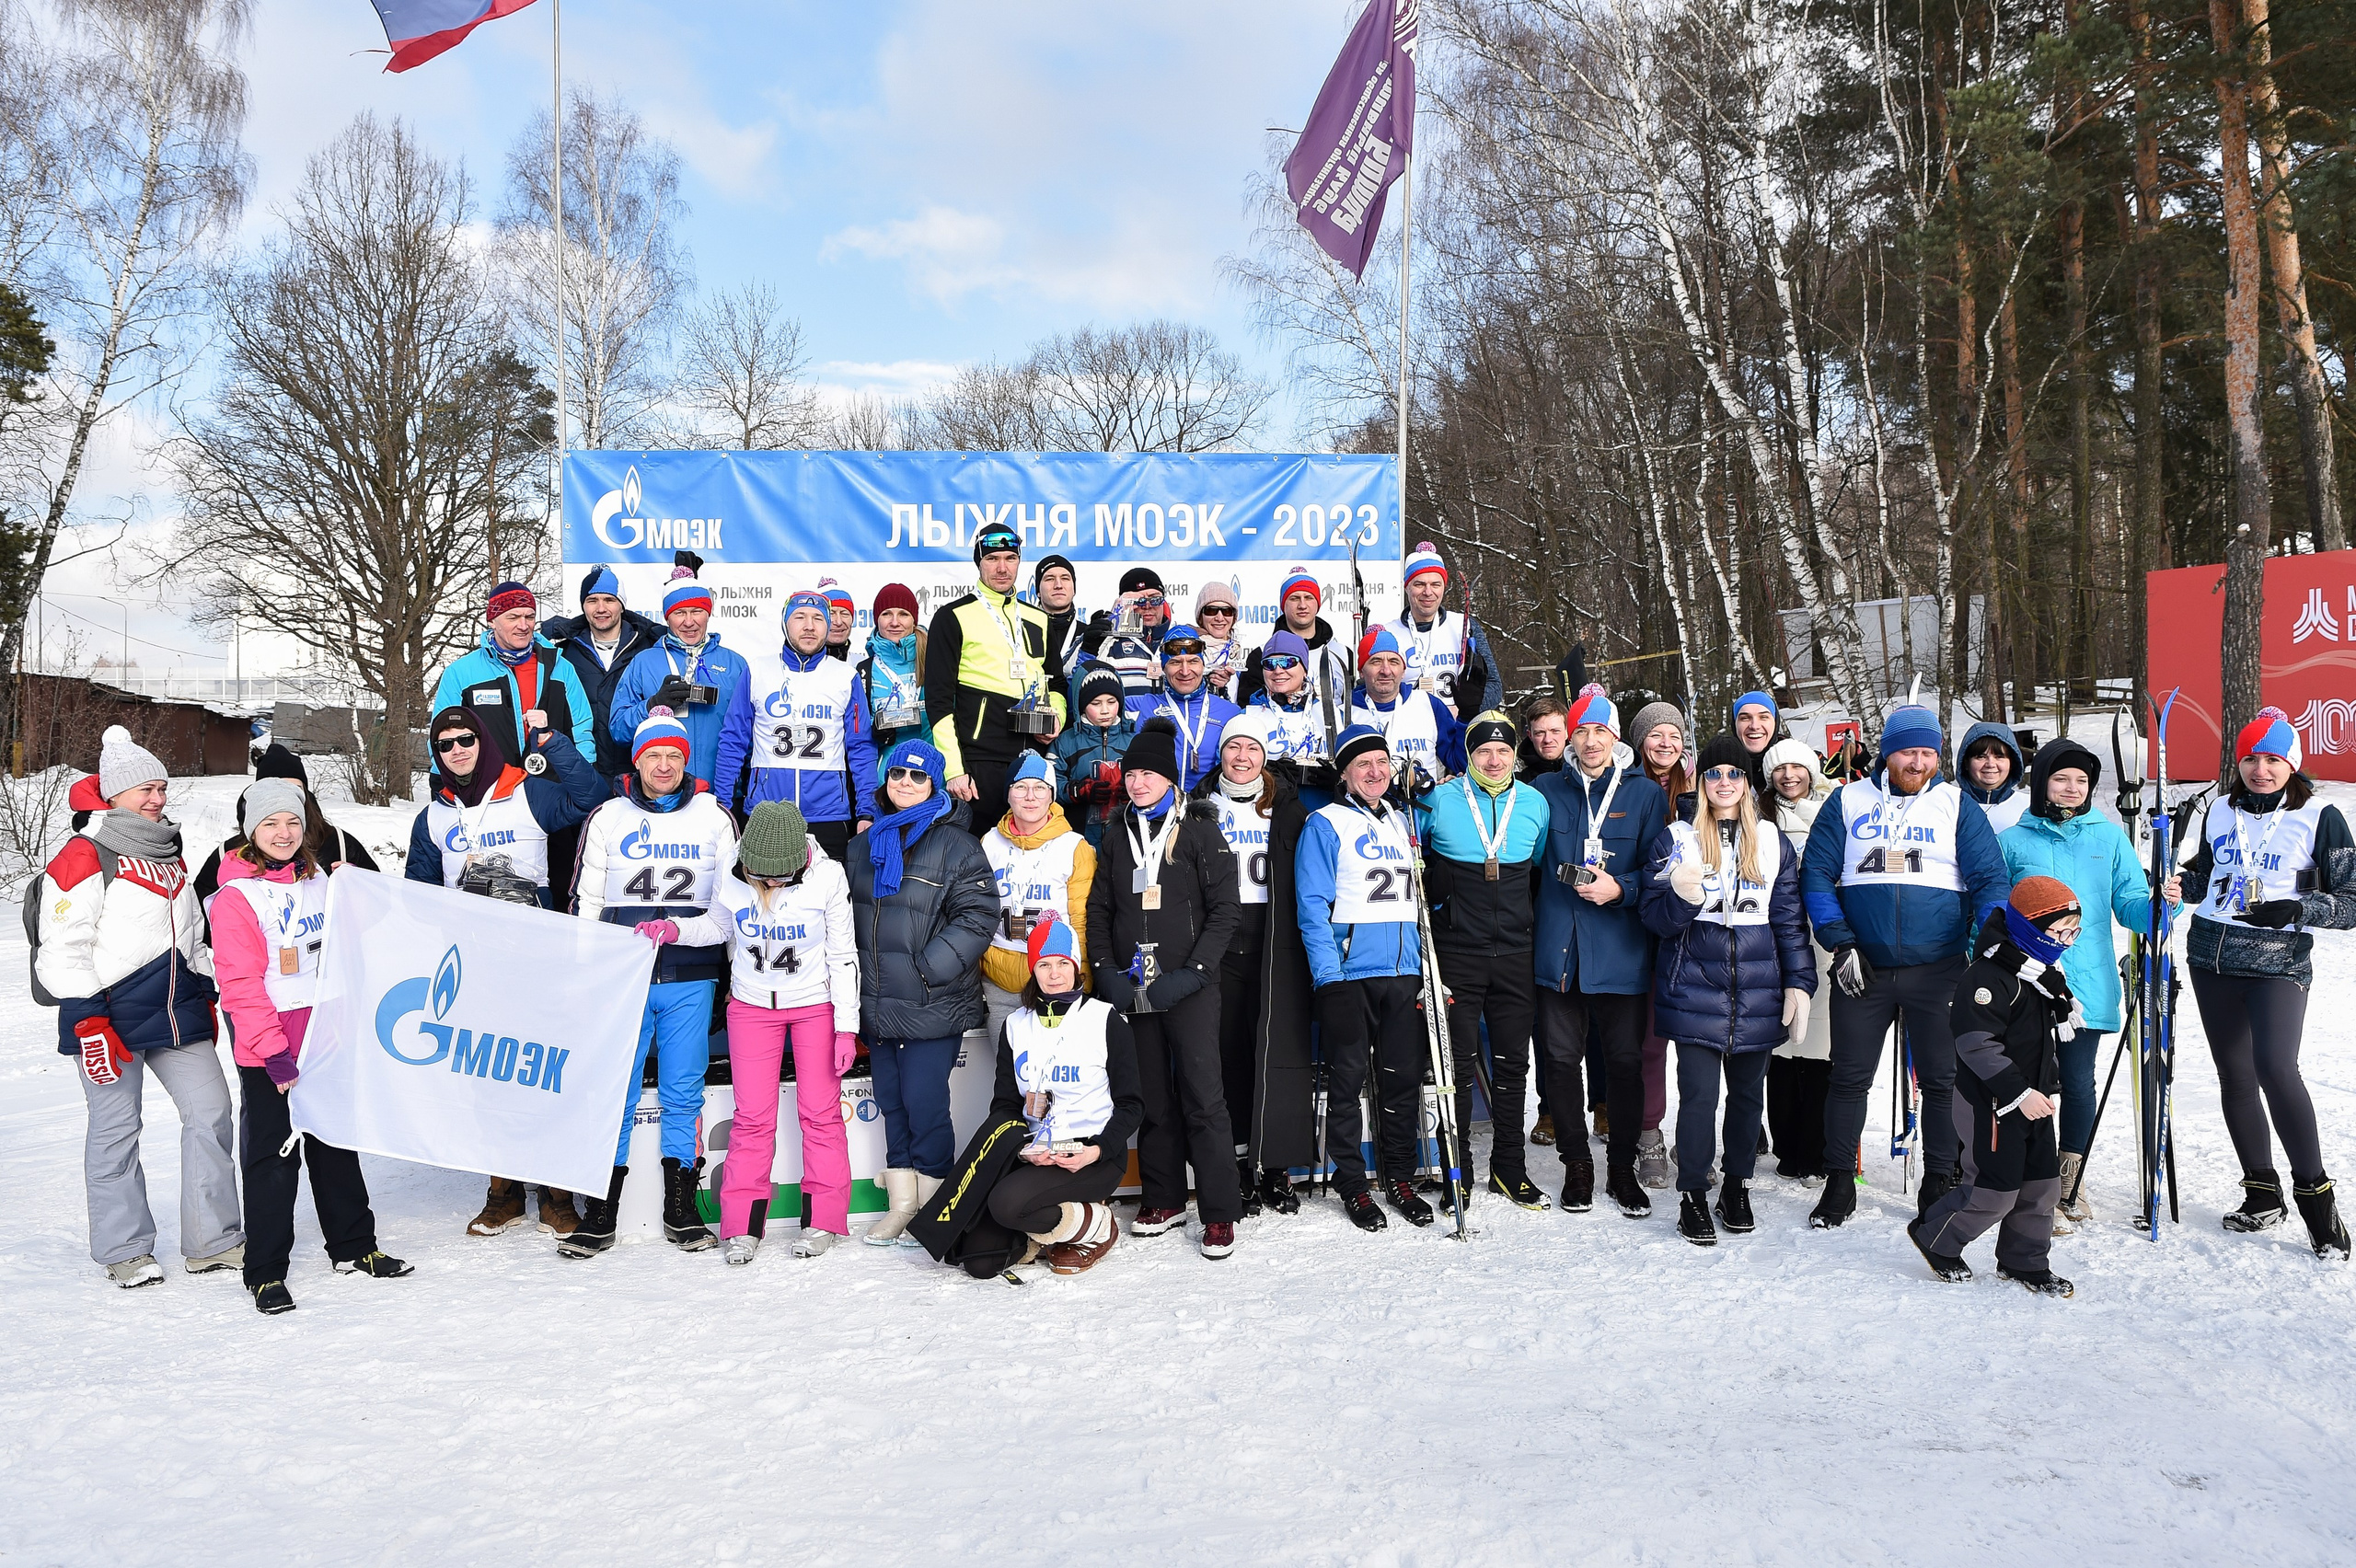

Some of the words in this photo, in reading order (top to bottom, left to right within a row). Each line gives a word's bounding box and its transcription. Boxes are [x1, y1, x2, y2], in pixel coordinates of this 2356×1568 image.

[646, 518, 722, 550] МОЭК
[886, 503, 1078, 548] ЛЫЖНЯ
[1094, 503, 1226, 548] МОЭК
[1242, 526, 1257, 535] -
[1273, 503, 1380, 547] 2023
[720, 586, 772, 599] ЛЫЖНЯ
[933, 585, 976, 598] ЛЫЖН
[721, 605, 757, 617] МОЭК
[1245, 605, 1282, 624] МОЭ
[772, 725, 825, 760] 32
[2158, 737, 2169, 816] ORDWAY
[1239, 830, 1269, 845] МОЭ
[654, 843, 701, 861] МОЭК
[1855, 847, 1923, 874] 41
[2235, 849, 2281, 871] МЭК
[623, 866, 696, 902] 42
[1026, 883, 1052, 901] ОЭК
[1366, 866, 1417, 904] 27
[762, 923, 807, 941] МОЭК
[745, 945, 802, 975] 14
[1144, 955, 1156, 976] 2
[84, 1038, 115, 1084] RUSSIA
[451, 1028, 570, 1093] МОЭК
[1051, 1065, 1080, 1083] ОЭК
[1052, 1143, 1083, 1151] МЕСТО
